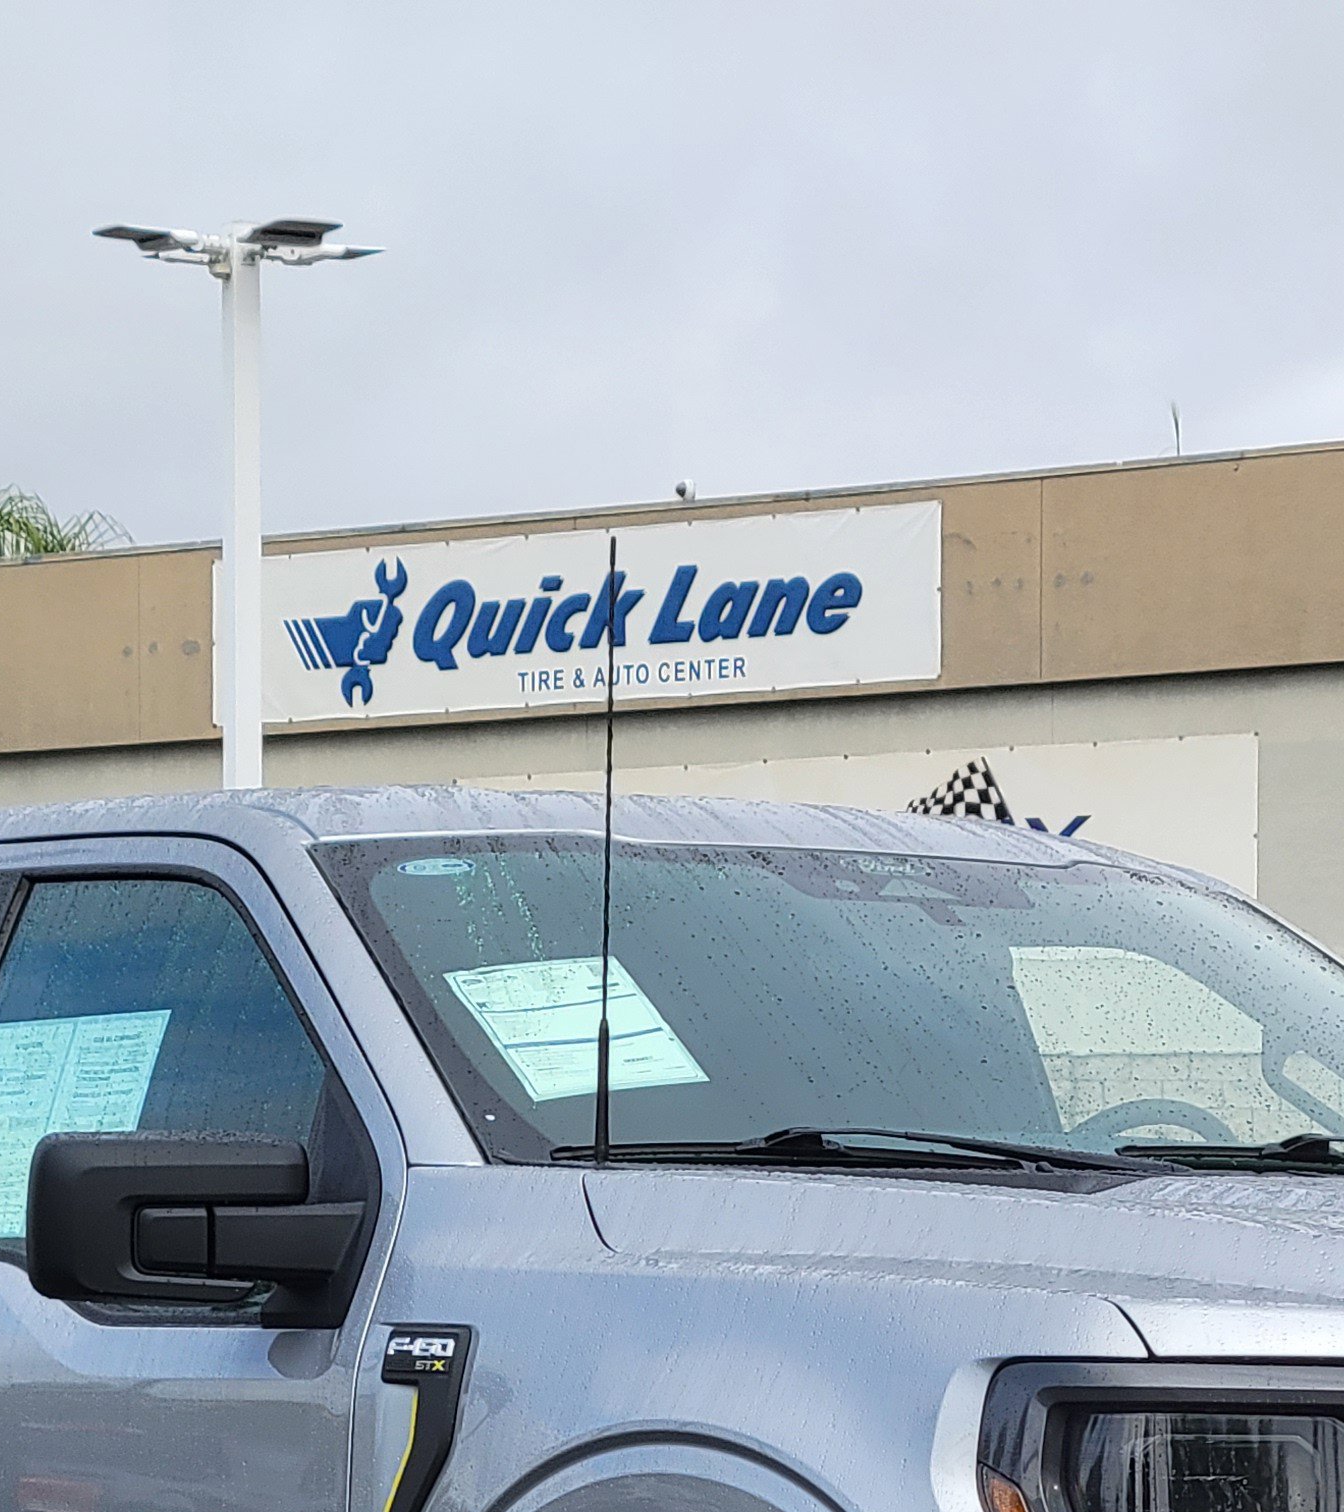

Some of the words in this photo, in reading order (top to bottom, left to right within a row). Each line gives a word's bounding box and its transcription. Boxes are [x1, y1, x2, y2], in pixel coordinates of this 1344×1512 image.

[412, 571, 647, 671] Quick
[648, 564, 862, 646] Lane
[517, 669, 565, 693] TIRE
[573, 667, 586, 690] &
[593, 663, 649, 687] AUTO
[658, 657, 746, 684] CENTER
[414, 1360, 446, 1371] STX
